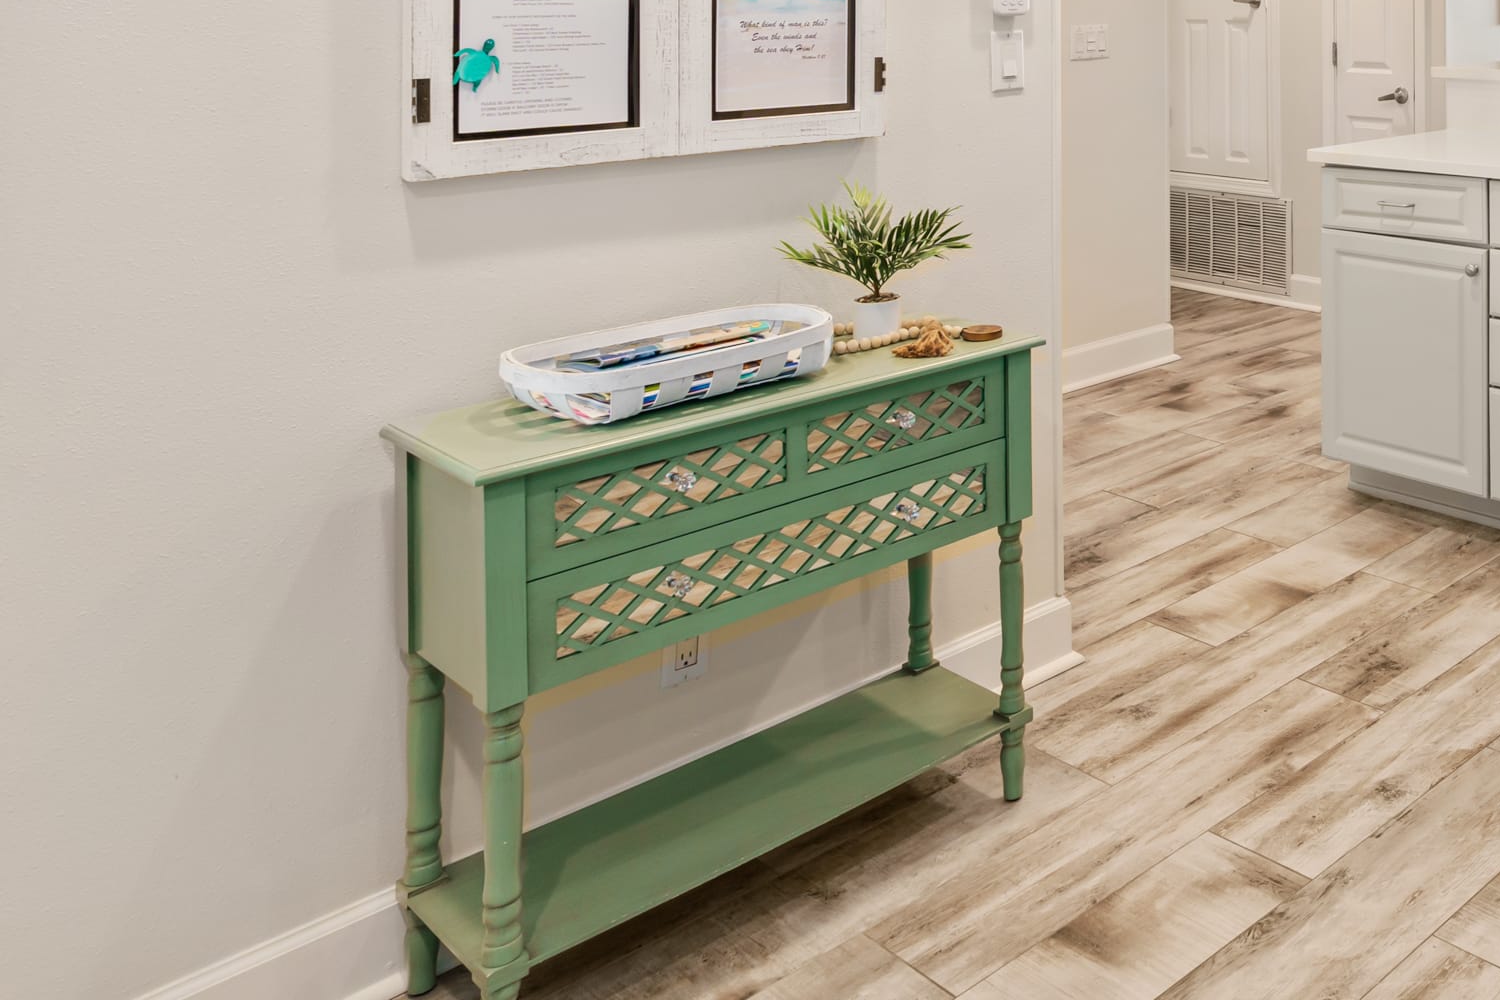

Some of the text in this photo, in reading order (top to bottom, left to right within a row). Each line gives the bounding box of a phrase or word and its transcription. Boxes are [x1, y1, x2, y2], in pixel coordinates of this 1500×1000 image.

[739, 20, 760, 32] What
[761, 20, 777, 28] kind
[779, 20, 786, 29] of
[751, 32, 769, 42] Even
[771, 32, 781, 40] the
[783, 32, 802, 40] winds
[779, 45, 794, 54] obey
